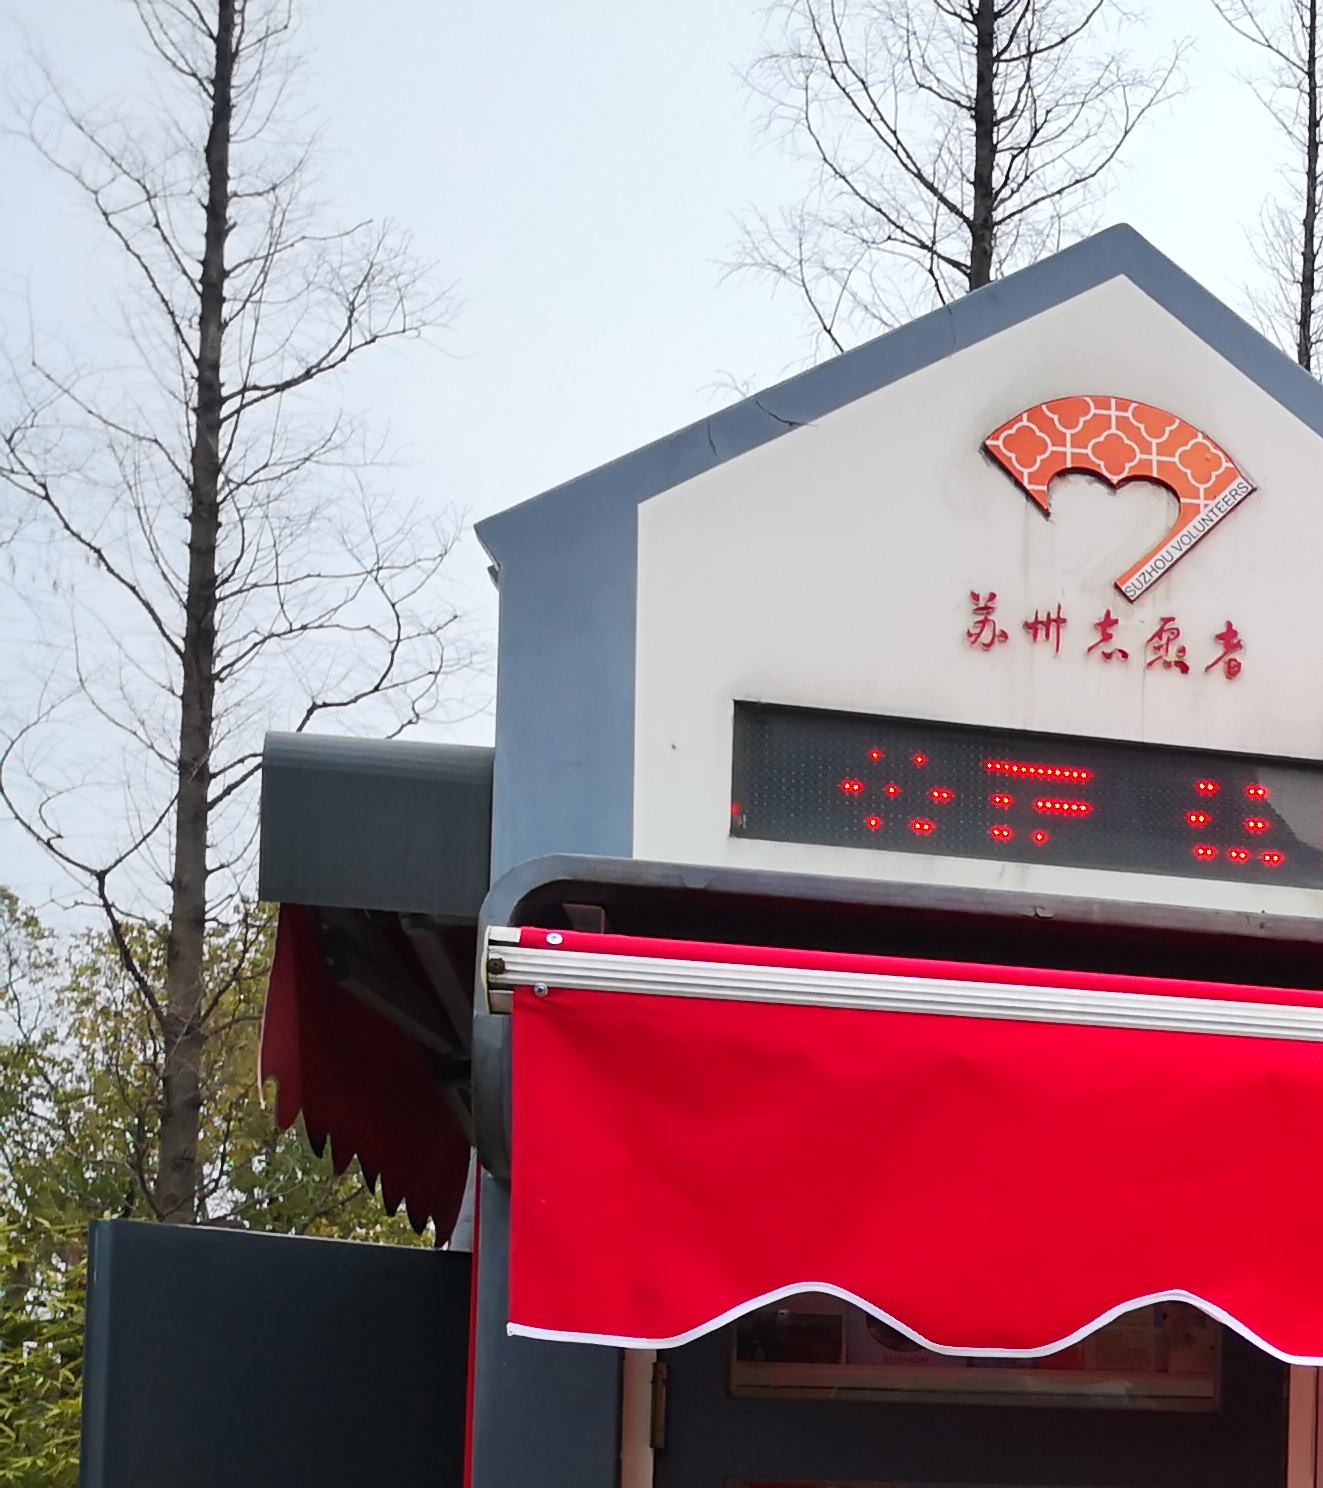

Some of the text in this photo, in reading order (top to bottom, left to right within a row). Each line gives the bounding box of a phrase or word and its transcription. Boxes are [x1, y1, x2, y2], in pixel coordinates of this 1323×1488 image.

[1124, 481, 1250, 599] SUZHOU VOLUNTEERS
[967, 591, 1243, 680] 苏州志愿者
